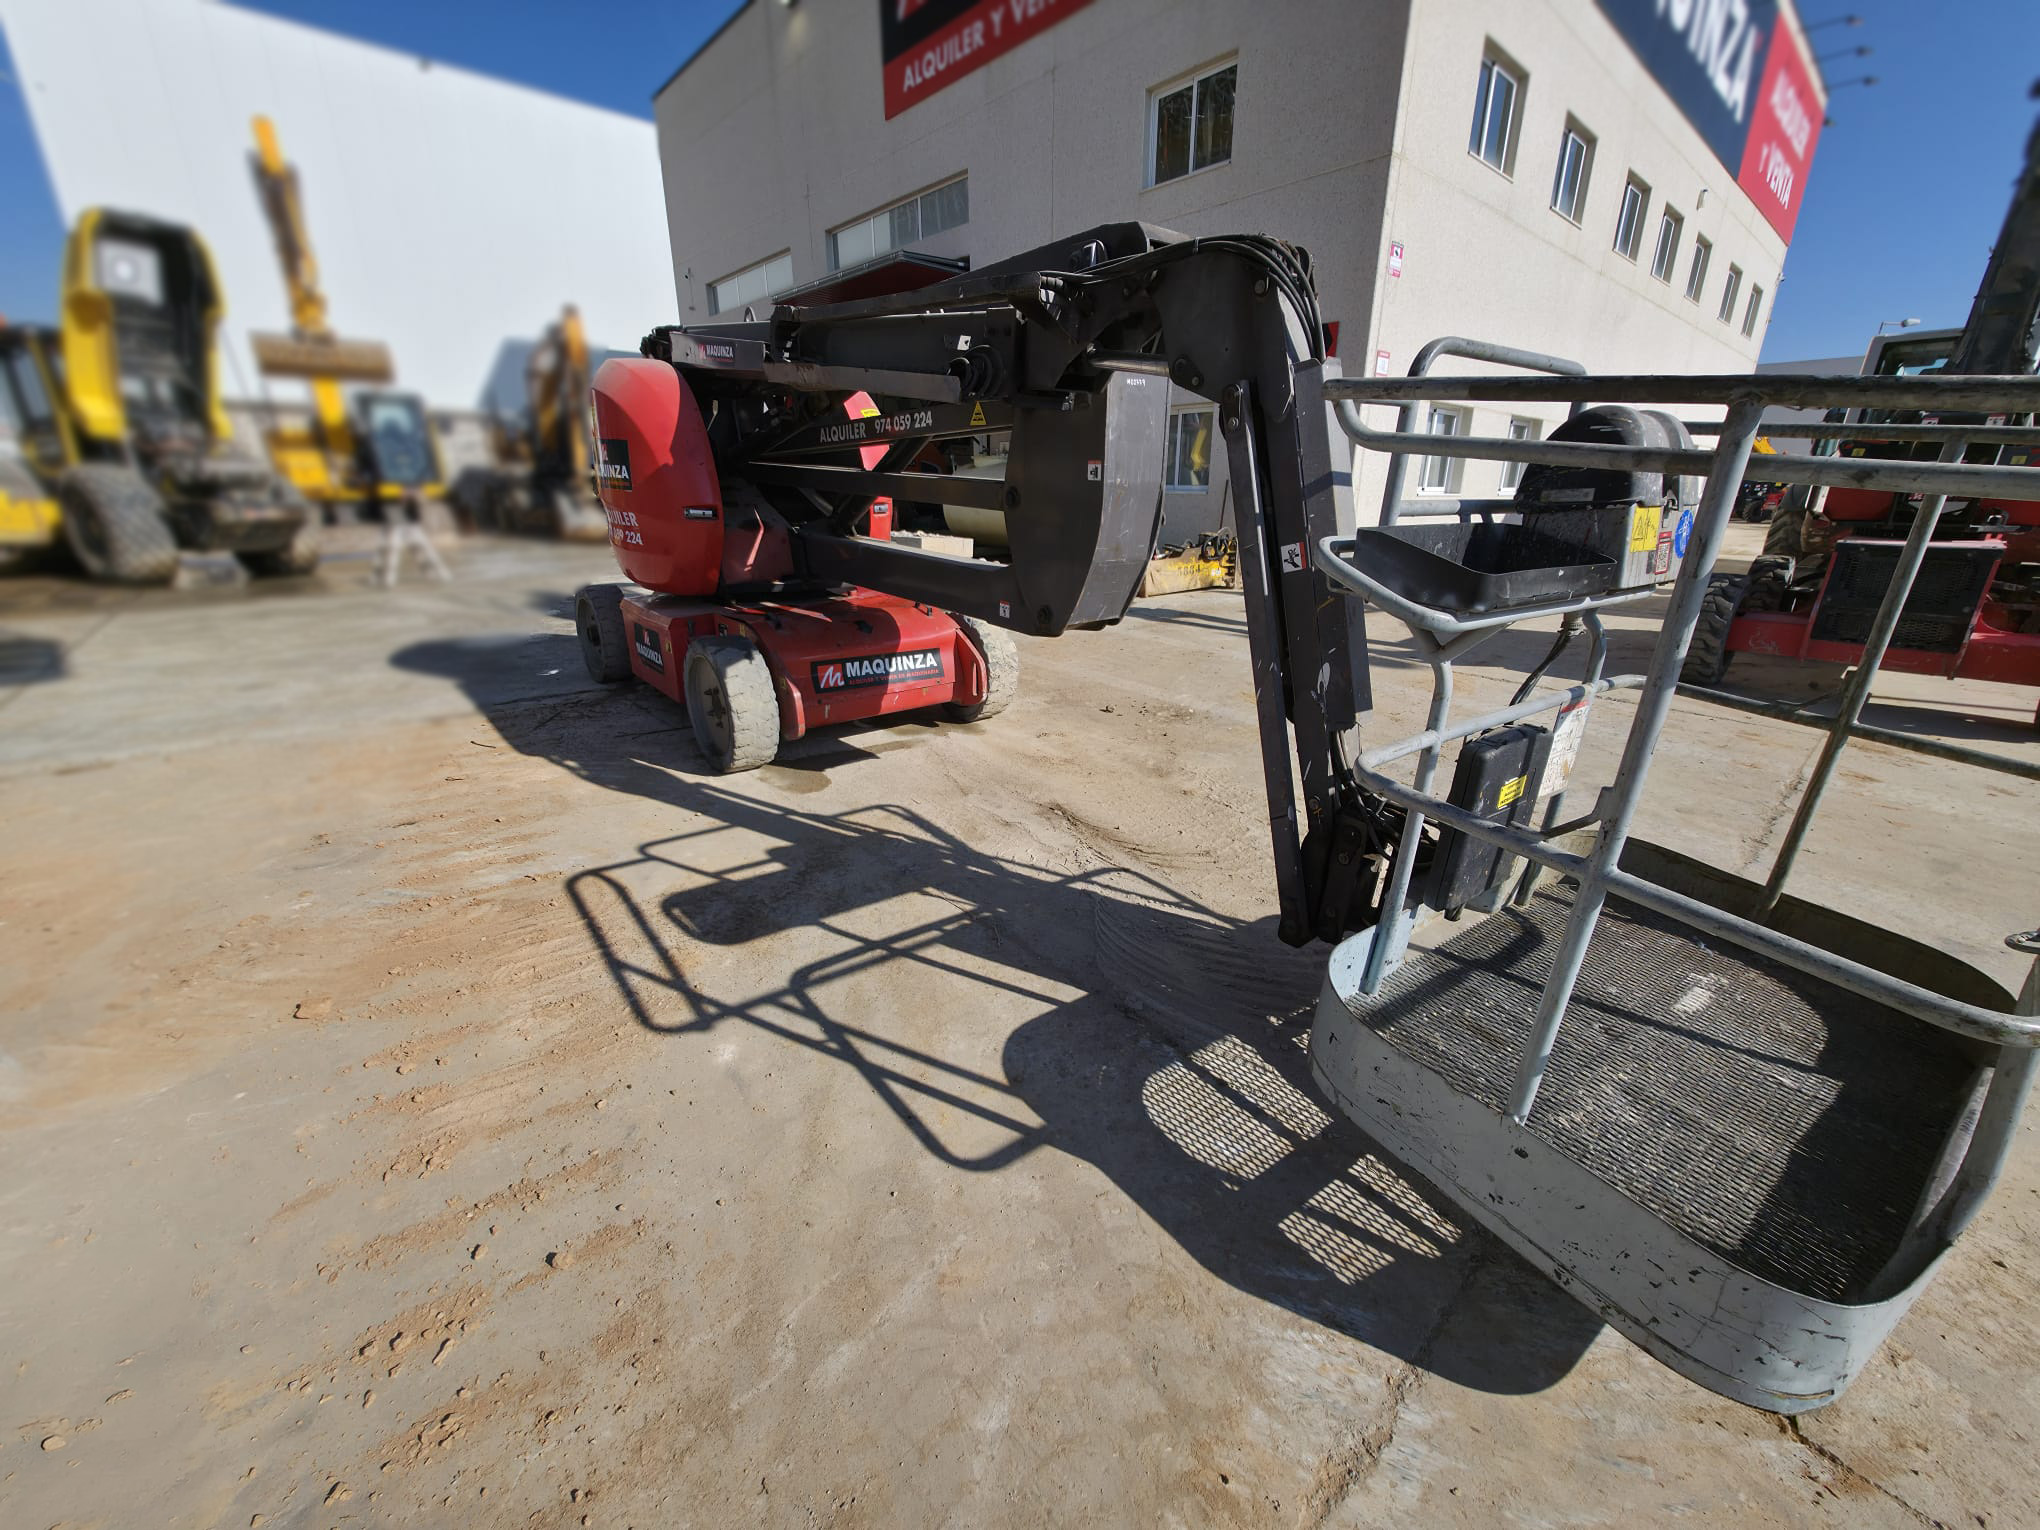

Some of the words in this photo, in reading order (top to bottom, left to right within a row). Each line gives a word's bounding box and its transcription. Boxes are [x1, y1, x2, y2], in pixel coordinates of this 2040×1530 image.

[903, 20, 985, 92] ALQUILER
[990, 6, 1004, 38] Y
[1657, 0, 1757, 123] INZA
[820, 422, 867, 443] ALQUILER
[874, 417, 891, 434] 974
[893, 414, 911, 431] 059
[914, 410, 932, 429] 224
[625, 530, 644, 545] 224
[845, 652, 938, 678] MAQUINZA
